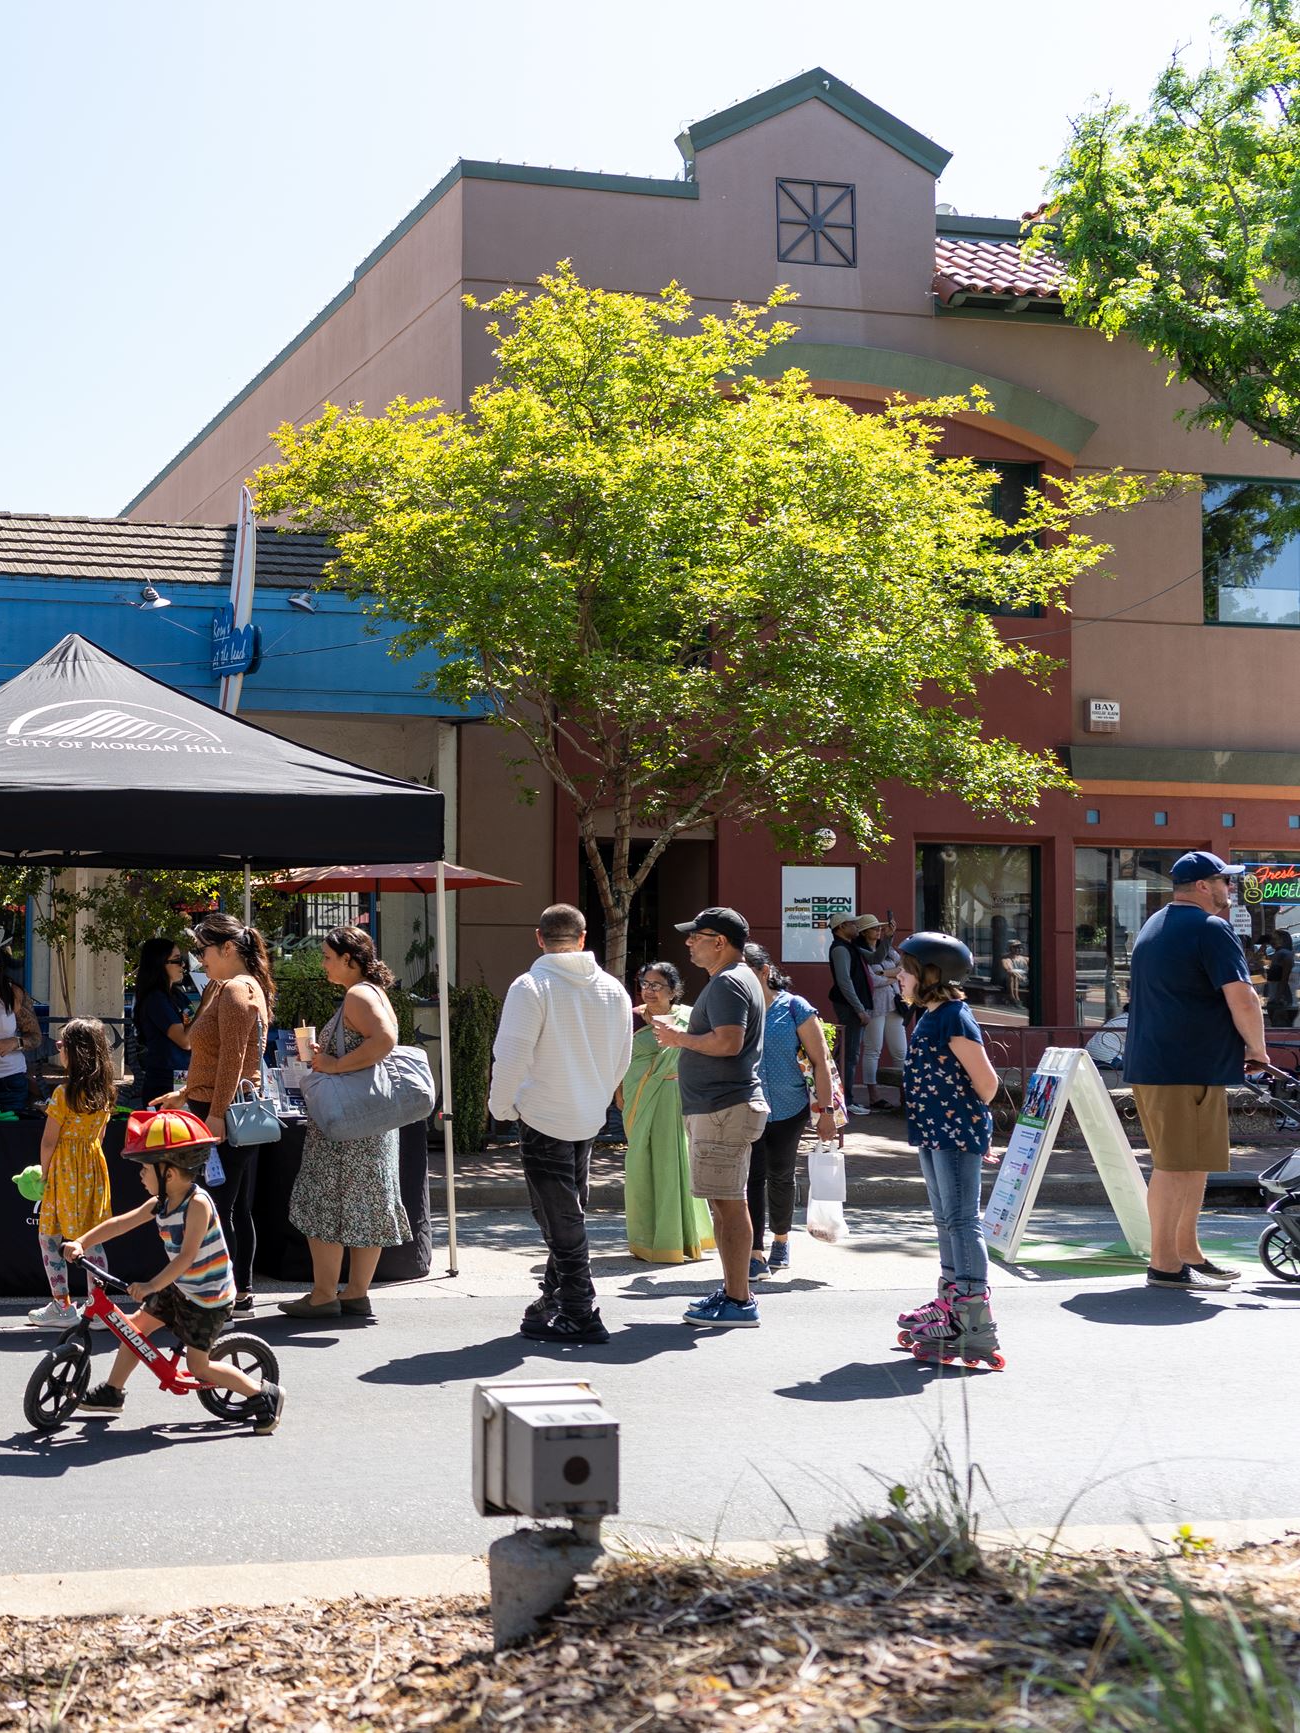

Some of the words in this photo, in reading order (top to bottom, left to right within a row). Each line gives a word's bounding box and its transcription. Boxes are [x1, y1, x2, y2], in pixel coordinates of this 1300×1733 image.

[1094, 703, 1115, 711] BAY
[5, 738, 53, 748] CITY
[58, 740, 83, 749] OF
[91, 741, 178, 752] MORGAN
[184, 744, 233, 755] HILL
[1255, 864, 1300, 883] Fresh
[107, 1311, 157, 1363] STRIDER
